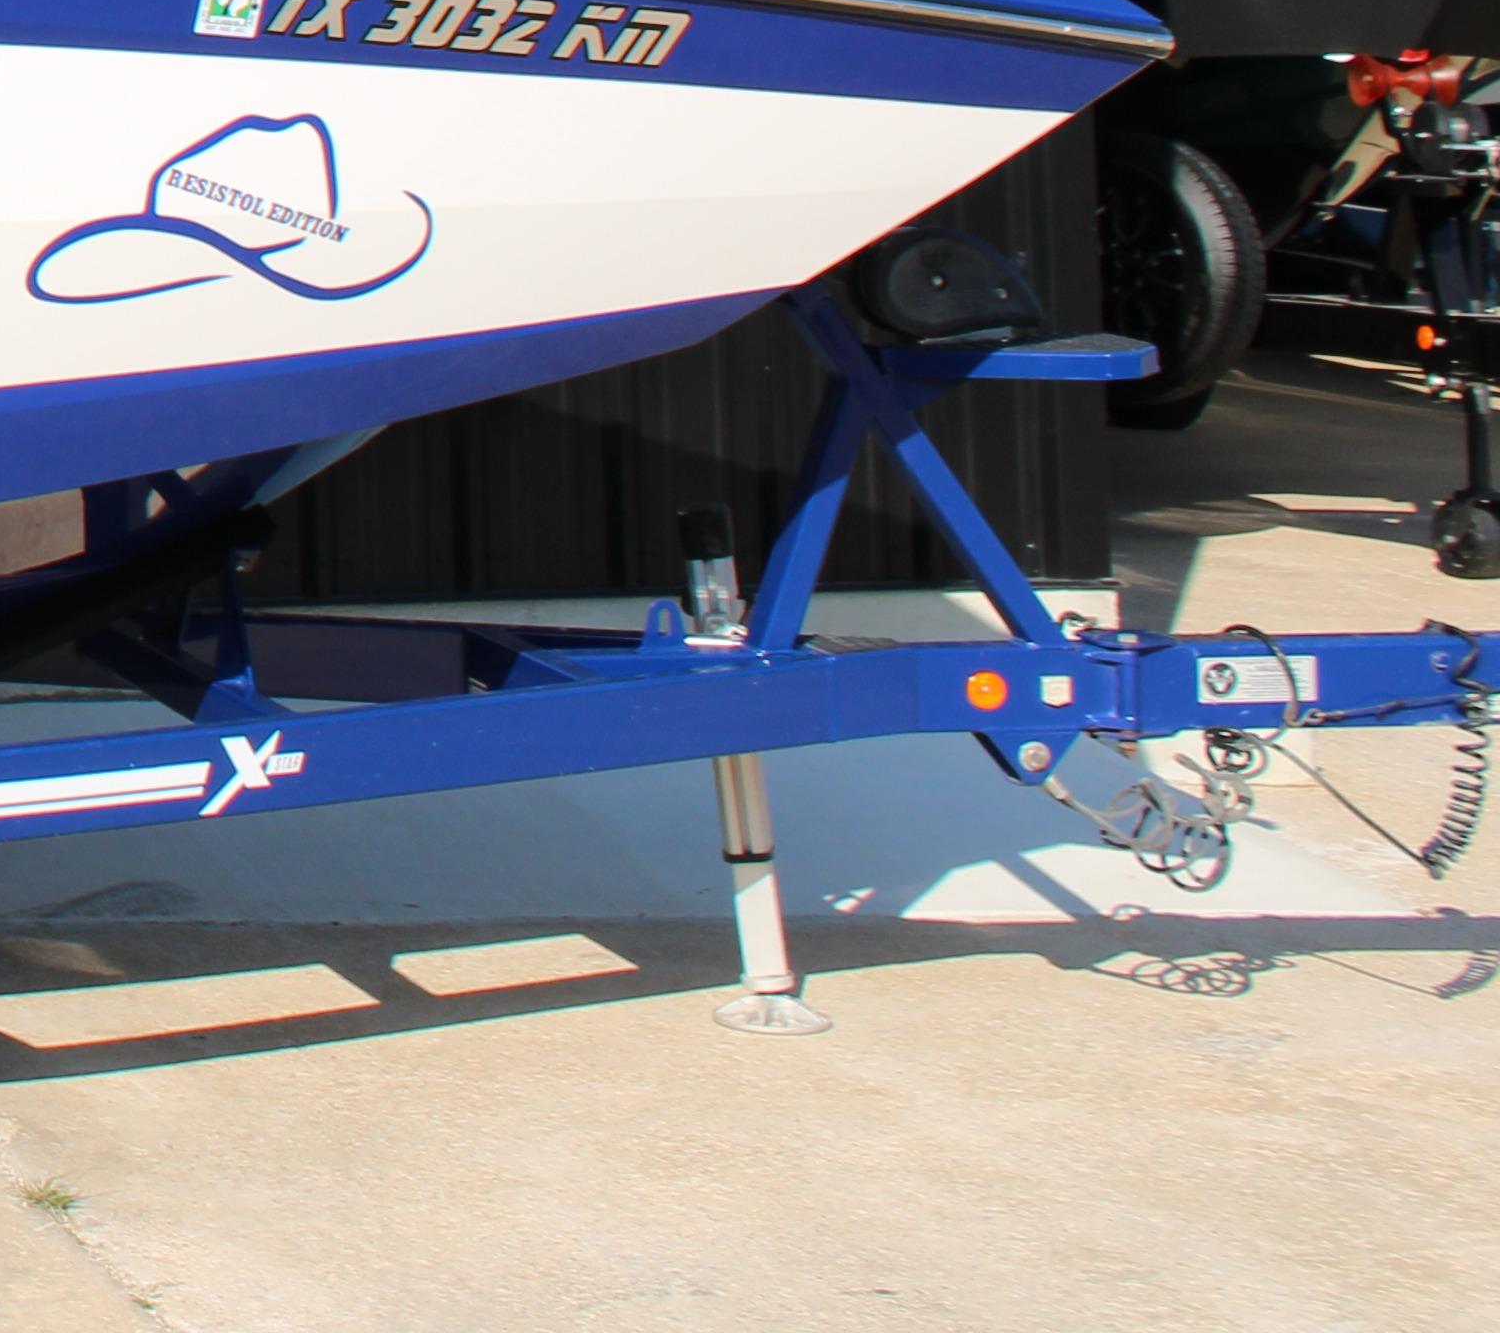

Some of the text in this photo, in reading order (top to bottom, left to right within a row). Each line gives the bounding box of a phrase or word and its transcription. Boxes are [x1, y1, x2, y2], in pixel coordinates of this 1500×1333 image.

[551, 2, 692, 67] KM
[164, 168, 350, 243] RESISTOL EDITION
